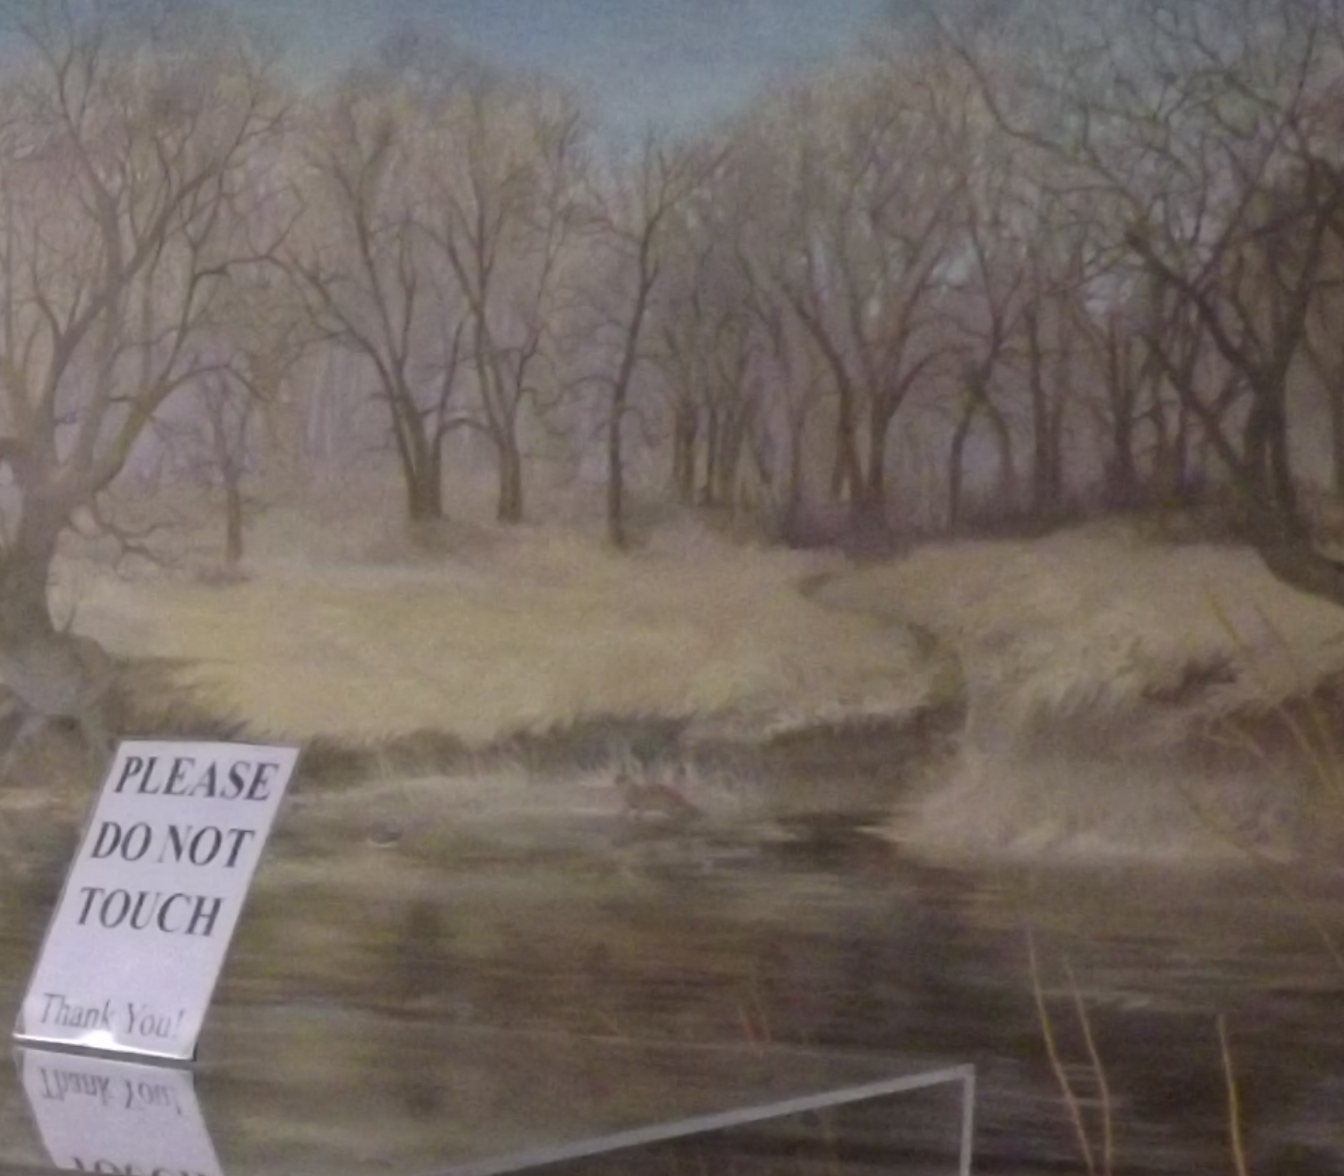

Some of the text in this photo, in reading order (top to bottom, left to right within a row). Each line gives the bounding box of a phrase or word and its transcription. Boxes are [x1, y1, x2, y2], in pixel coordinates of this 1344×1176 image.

[114, 756, 280, 801] PLEASE
[90, 821, 256, 868] DO NOT
[77, 886, 223, 937] TOUCH
[39, 992, 185, 1040] Thank You!
